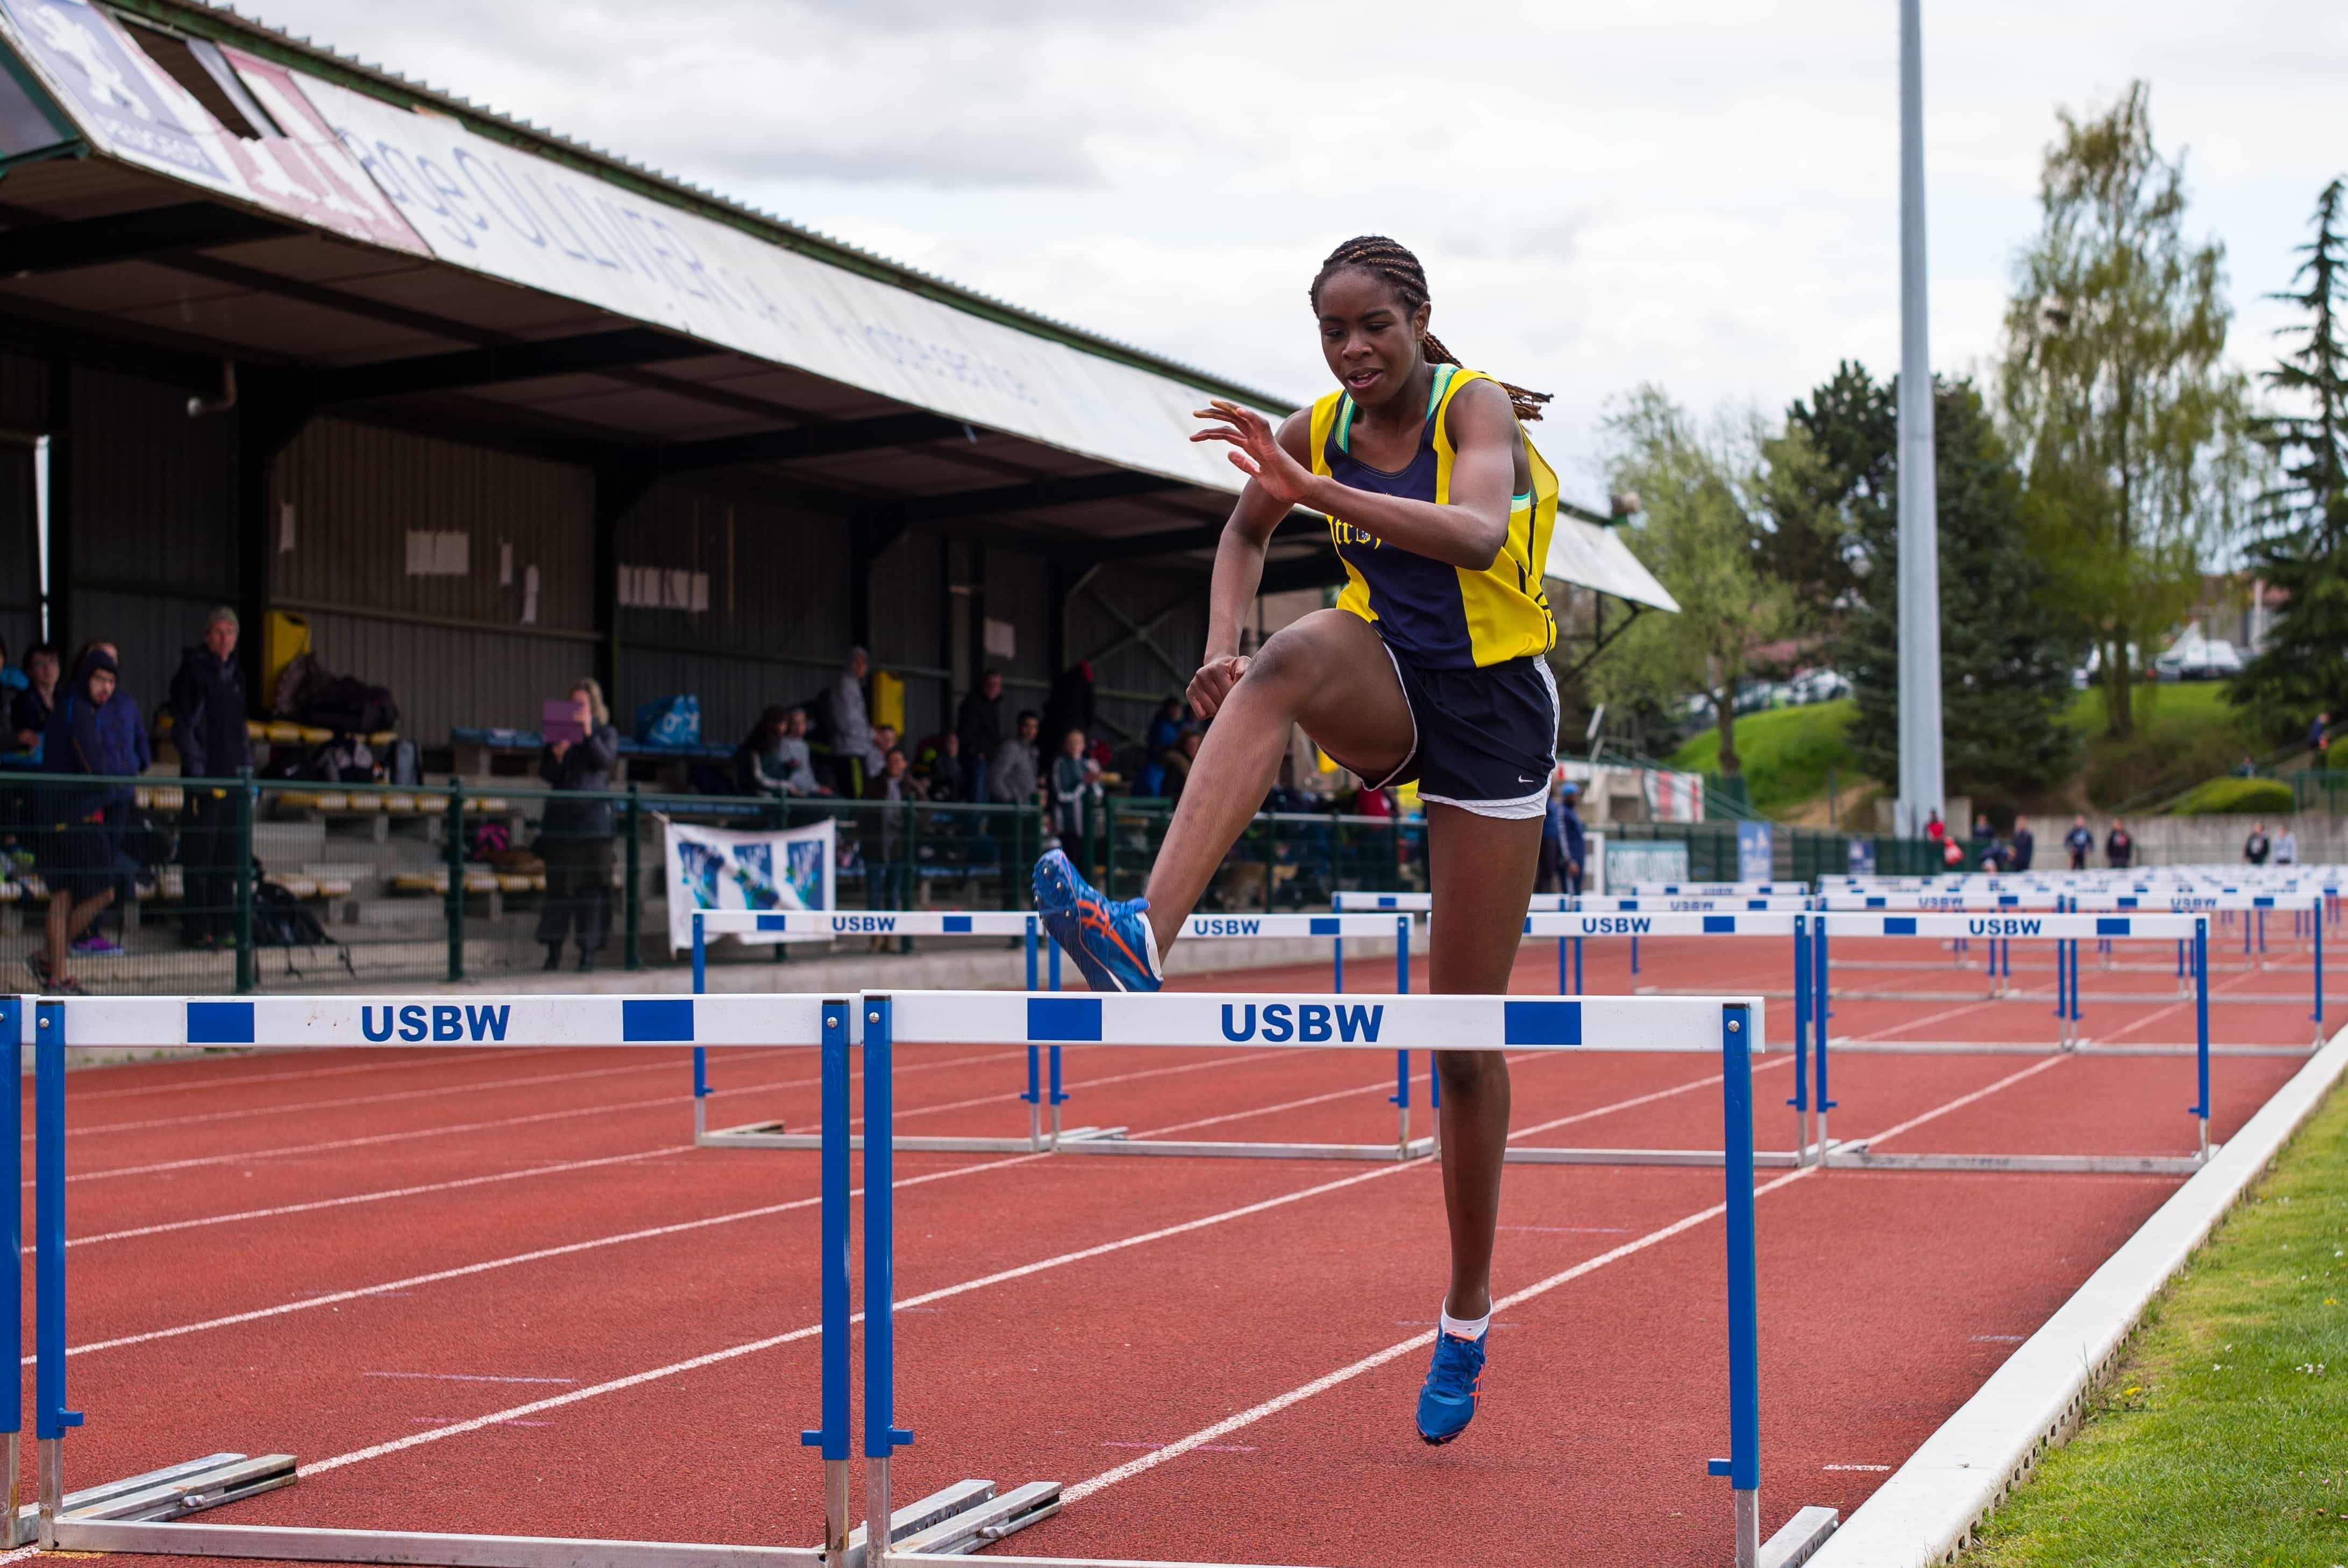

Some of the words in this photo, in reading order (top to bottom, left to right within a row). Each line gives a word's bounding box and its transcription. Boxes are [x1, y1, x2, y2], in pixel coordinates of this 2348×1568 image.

[832, 916, 895, 931] USBW
[1194, 919, 1260, 935] USBW
[1582, 917, 1650, 933] USBW
[1969, 918, 2041, 935] USBW
[362, 1004, 511, 1042] USBW
[1221, 1003, 1384, 1042] USBW
